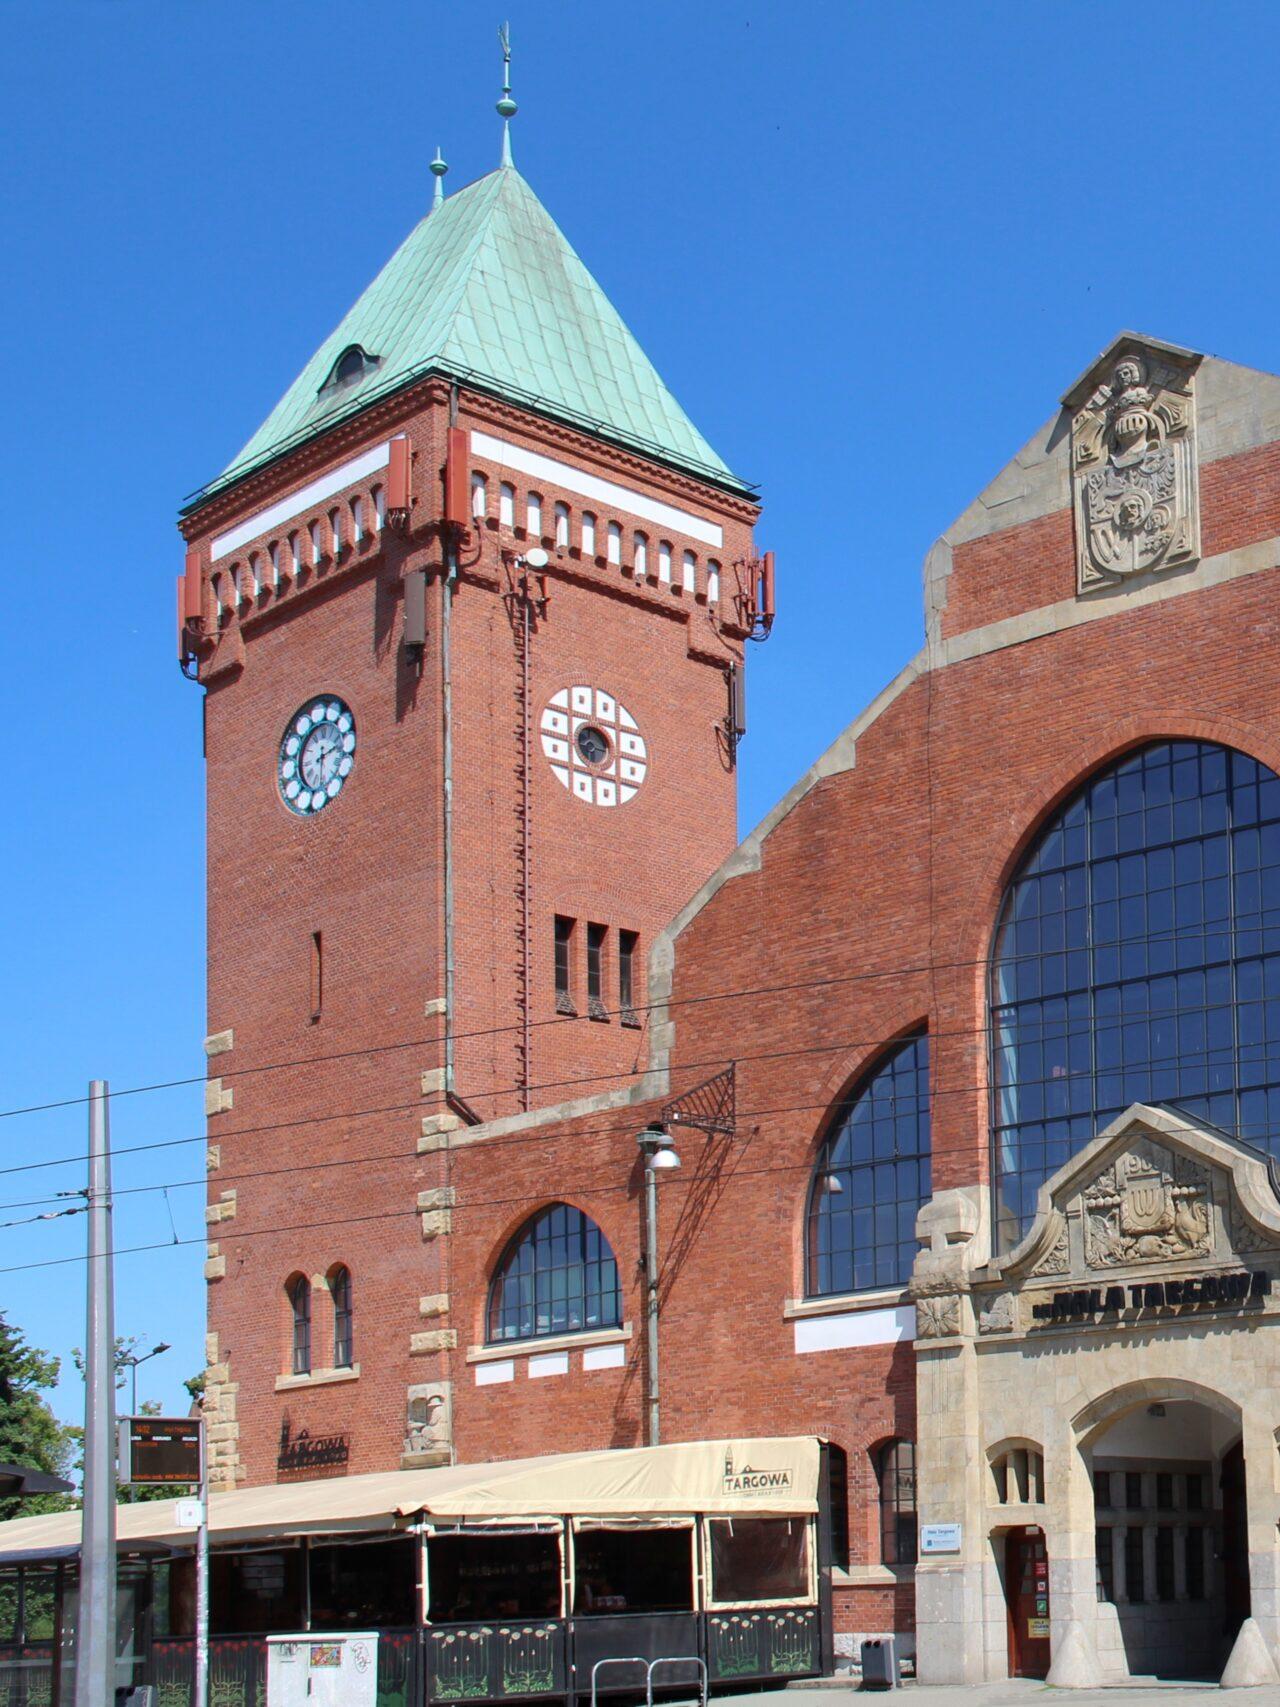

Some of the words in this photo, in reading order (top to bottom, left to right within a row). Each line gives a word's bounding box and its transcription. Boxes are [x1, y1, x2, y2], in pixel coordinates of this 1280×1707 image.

[1122, 1155, 1161, 1176] 190
[1054, 1287, 1126, 1317] HALA
[1128, 1271, 1267, 1309] TARGOWA
[725, 1472, 789, 1491] TARGOWA
